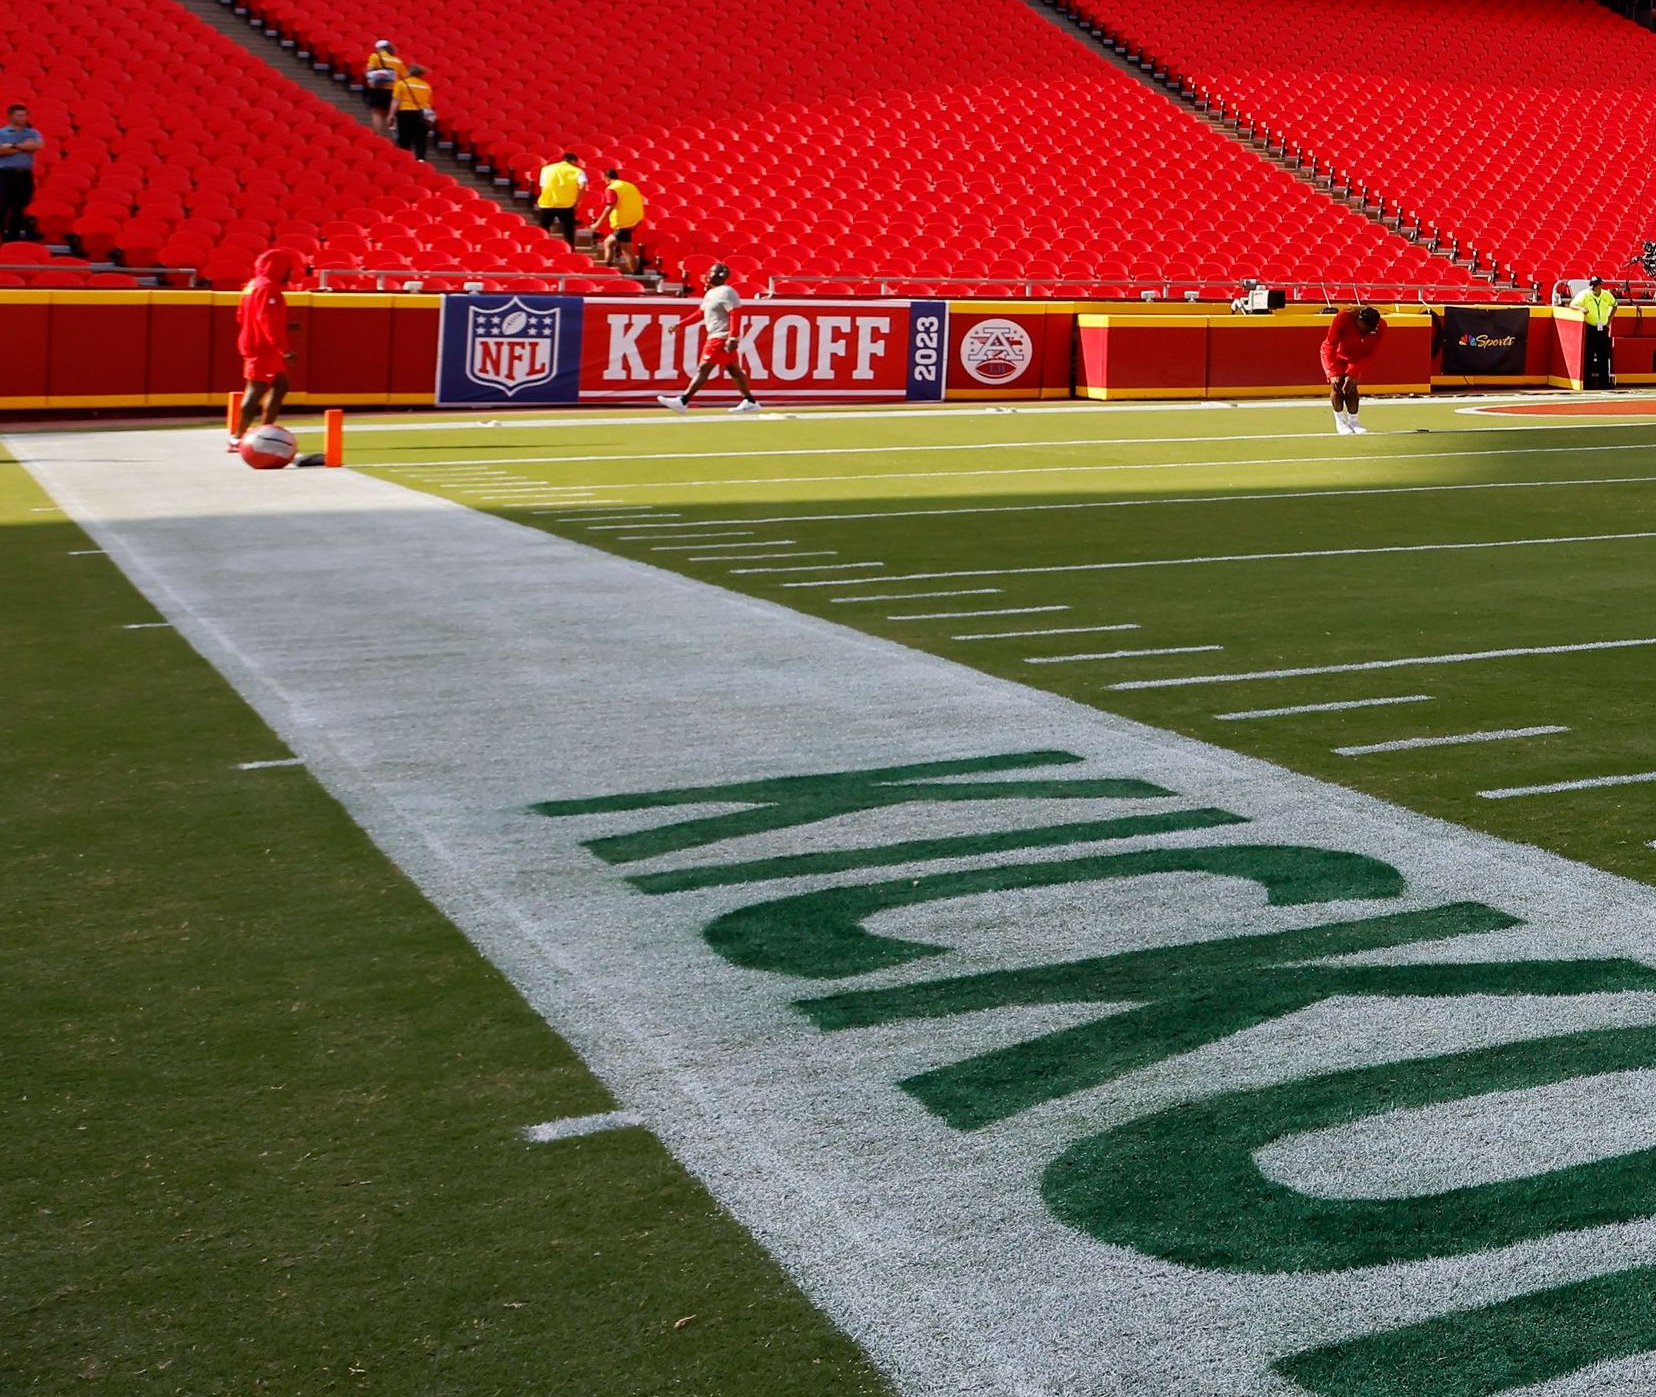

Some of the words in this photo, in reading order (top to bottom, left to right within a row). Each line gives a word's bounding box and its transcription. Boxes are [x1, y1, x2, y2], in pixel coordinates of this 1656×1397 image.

[478, 341, 550, 378] NFL
[914, 316, 939, 382] 2023
[1476, 334, 1515, 349] Sports
